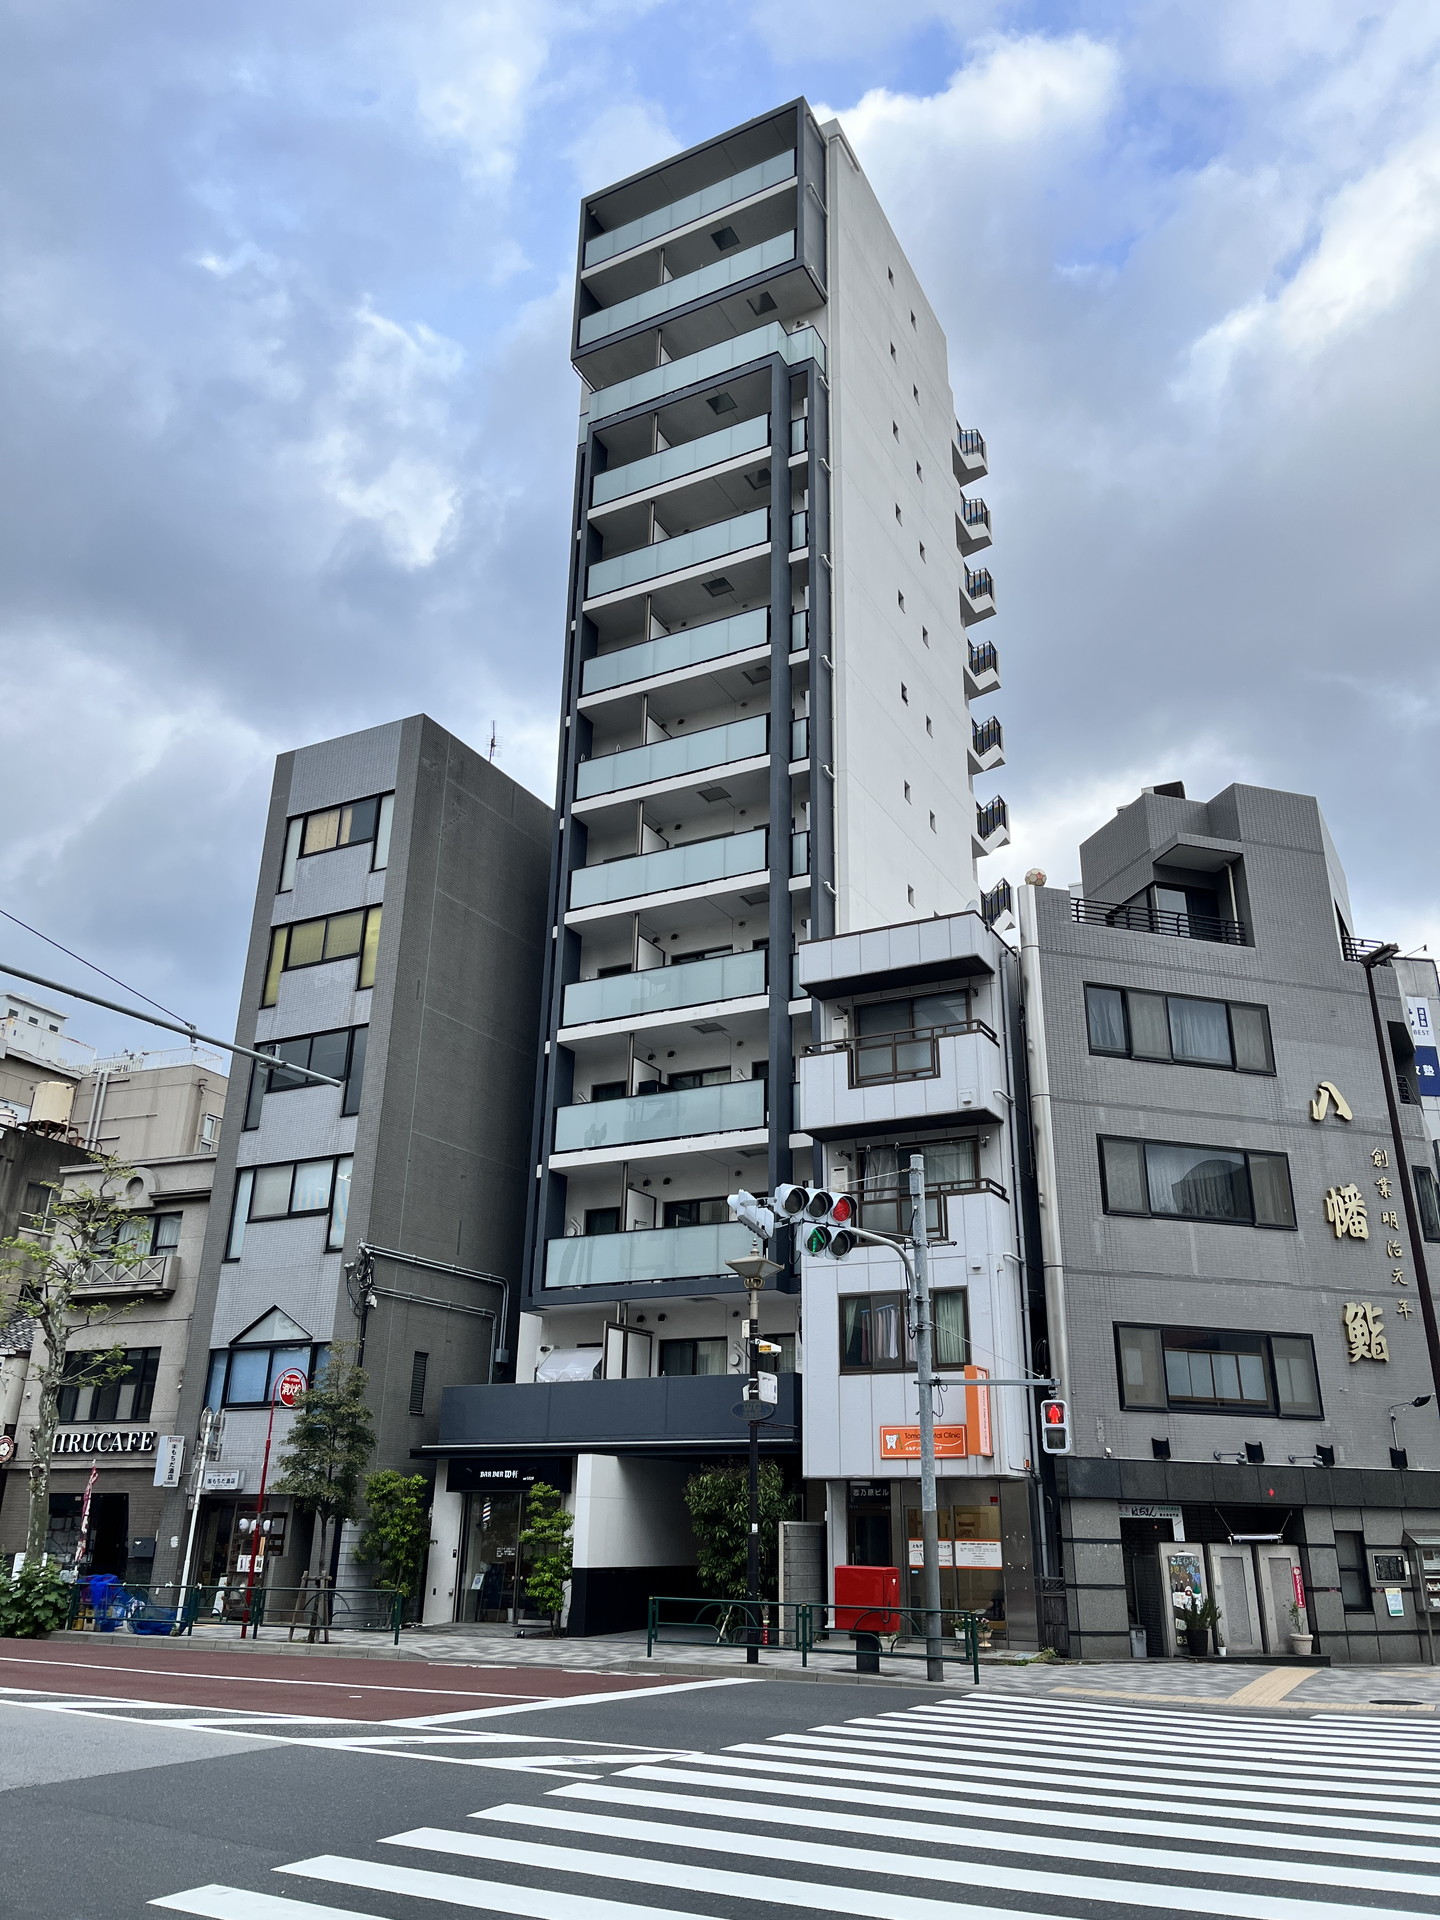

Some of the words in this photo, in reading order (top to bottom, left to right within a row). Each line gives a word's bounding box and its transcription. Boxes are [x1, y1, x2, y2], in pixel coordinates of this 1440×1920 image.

[1310, 1080, 1389, 1363] 八幡鮨
[1371, 1147, 1413, 1320] 創業明治元年
